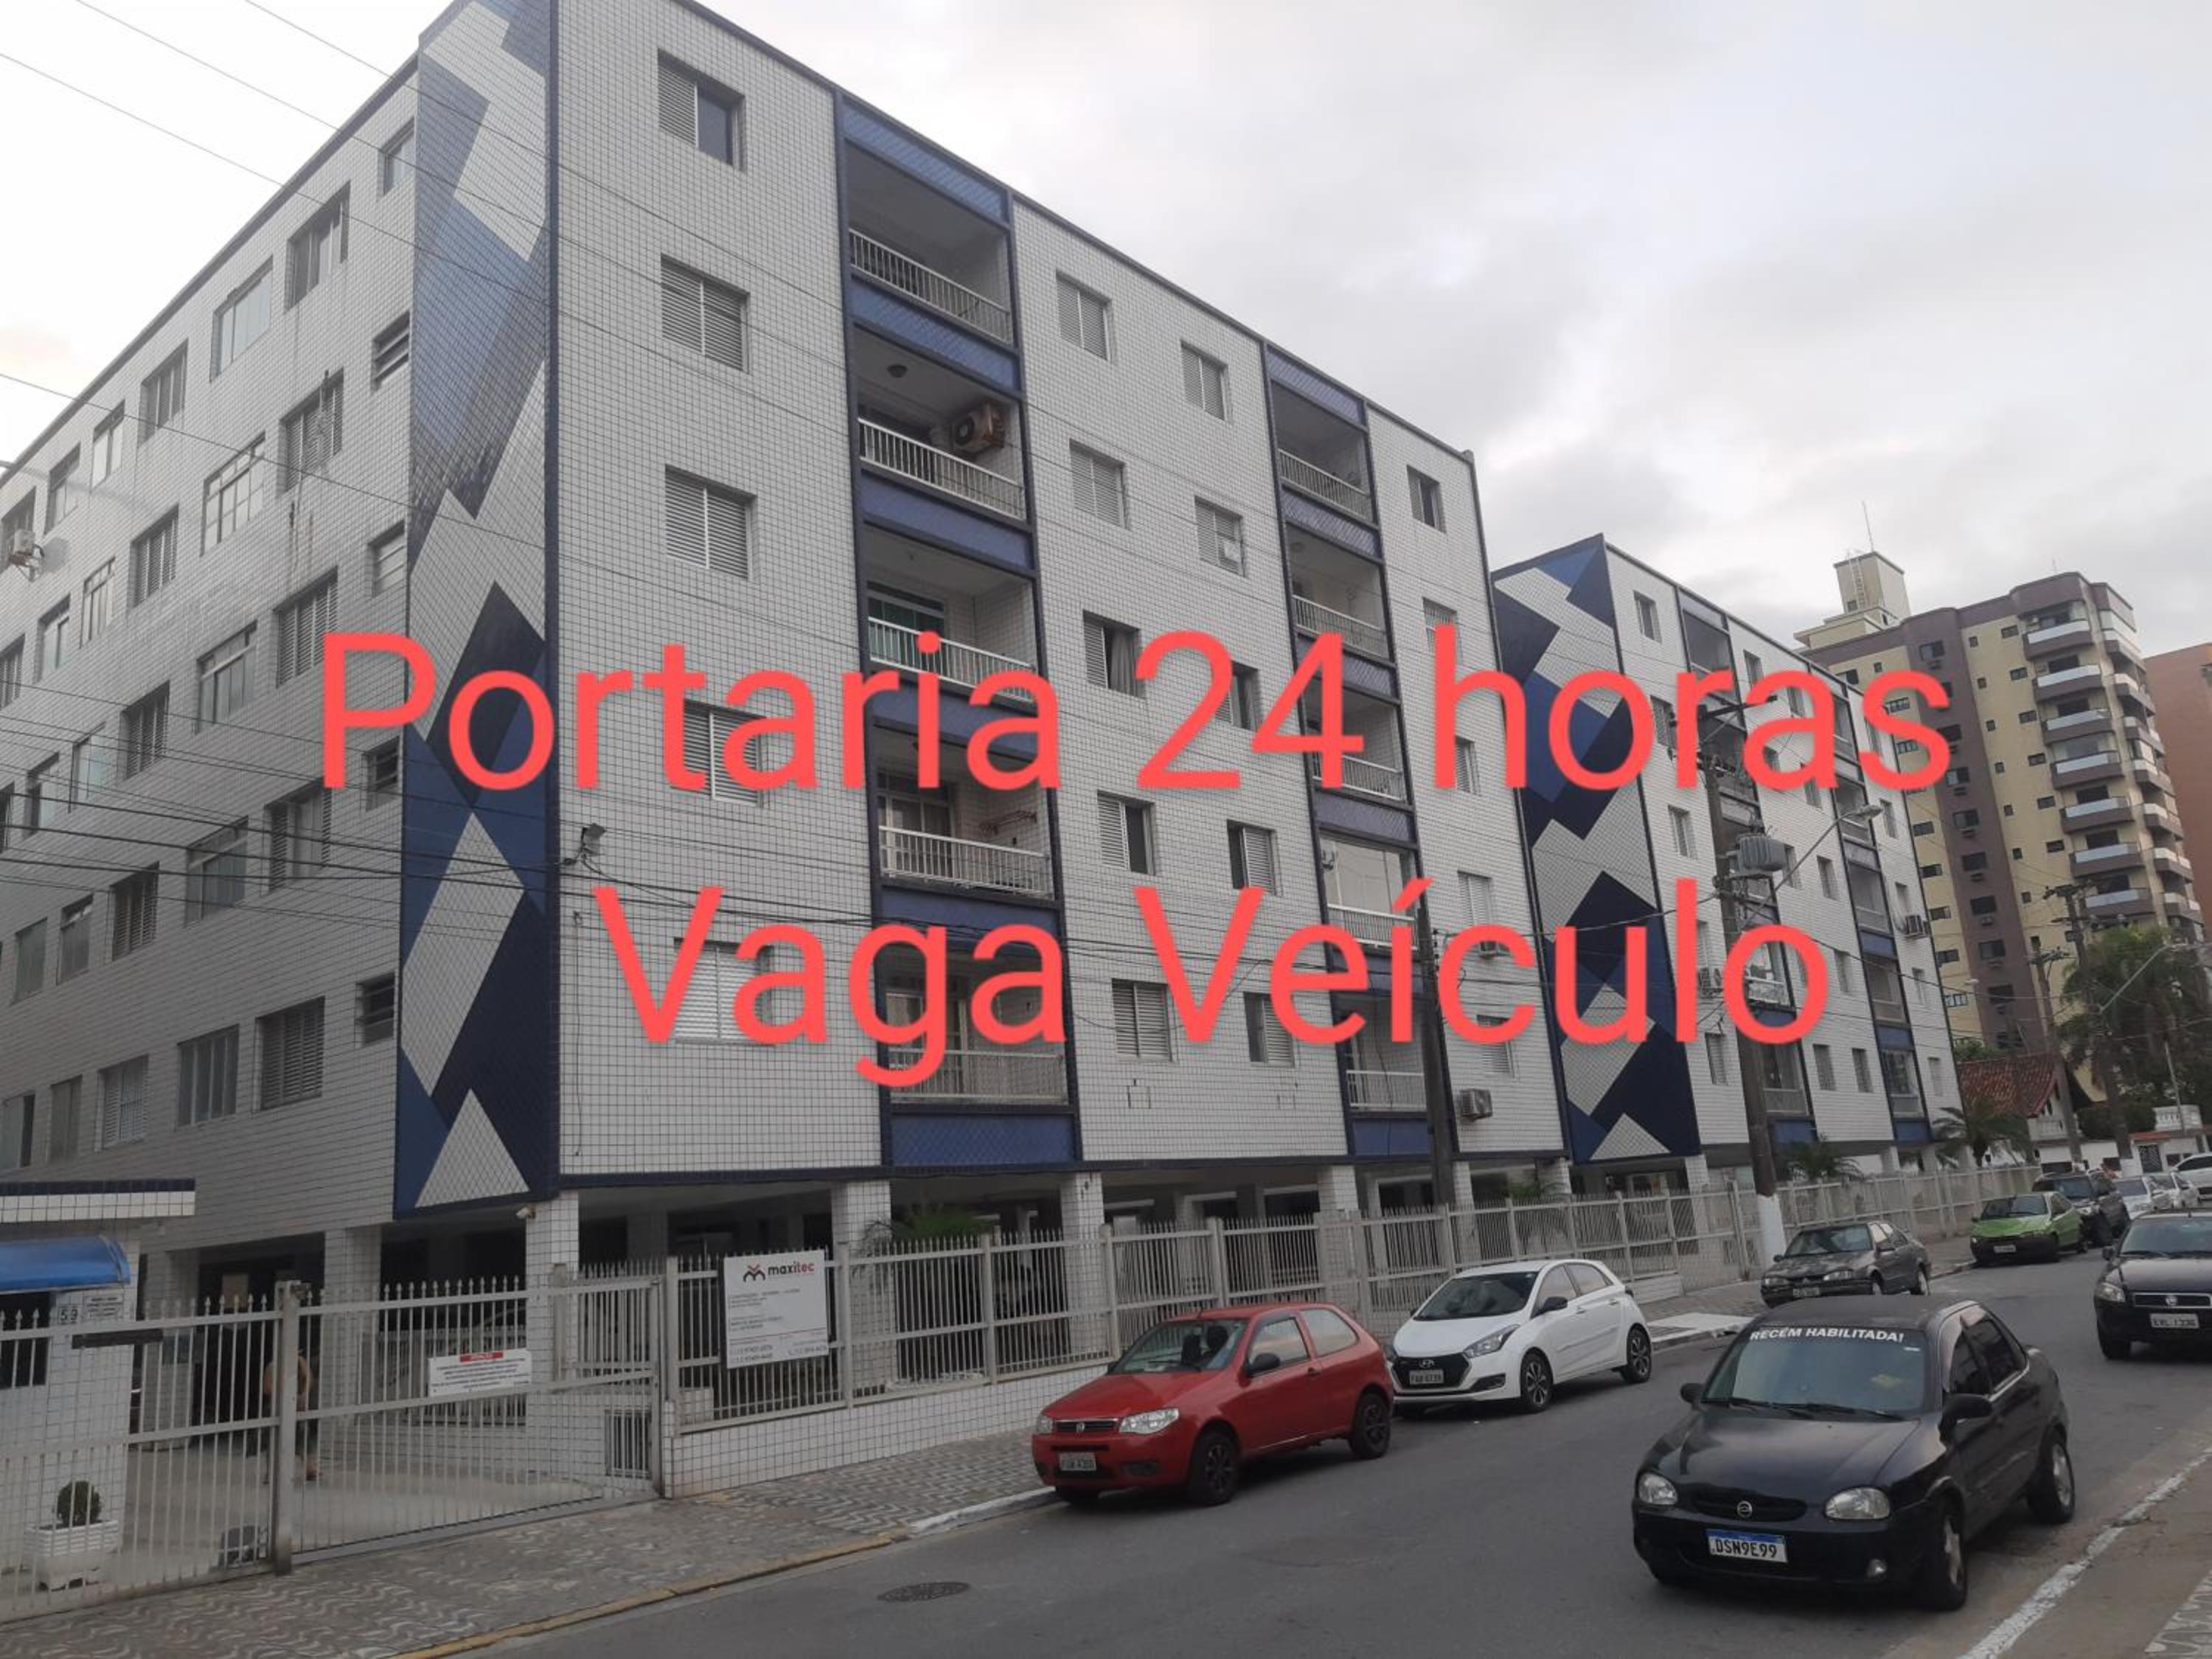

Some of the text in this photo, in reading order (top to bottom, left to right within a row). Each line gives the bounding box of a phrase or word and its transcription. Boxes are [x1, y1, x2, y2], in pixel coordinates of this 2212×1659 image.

[768, 1260, 815, 1276] maxitec
[1750, 1326, 1905, 1343] RECÉM HABILITADA!
[1714, 1538, 1778, 1559] DSN9E99
